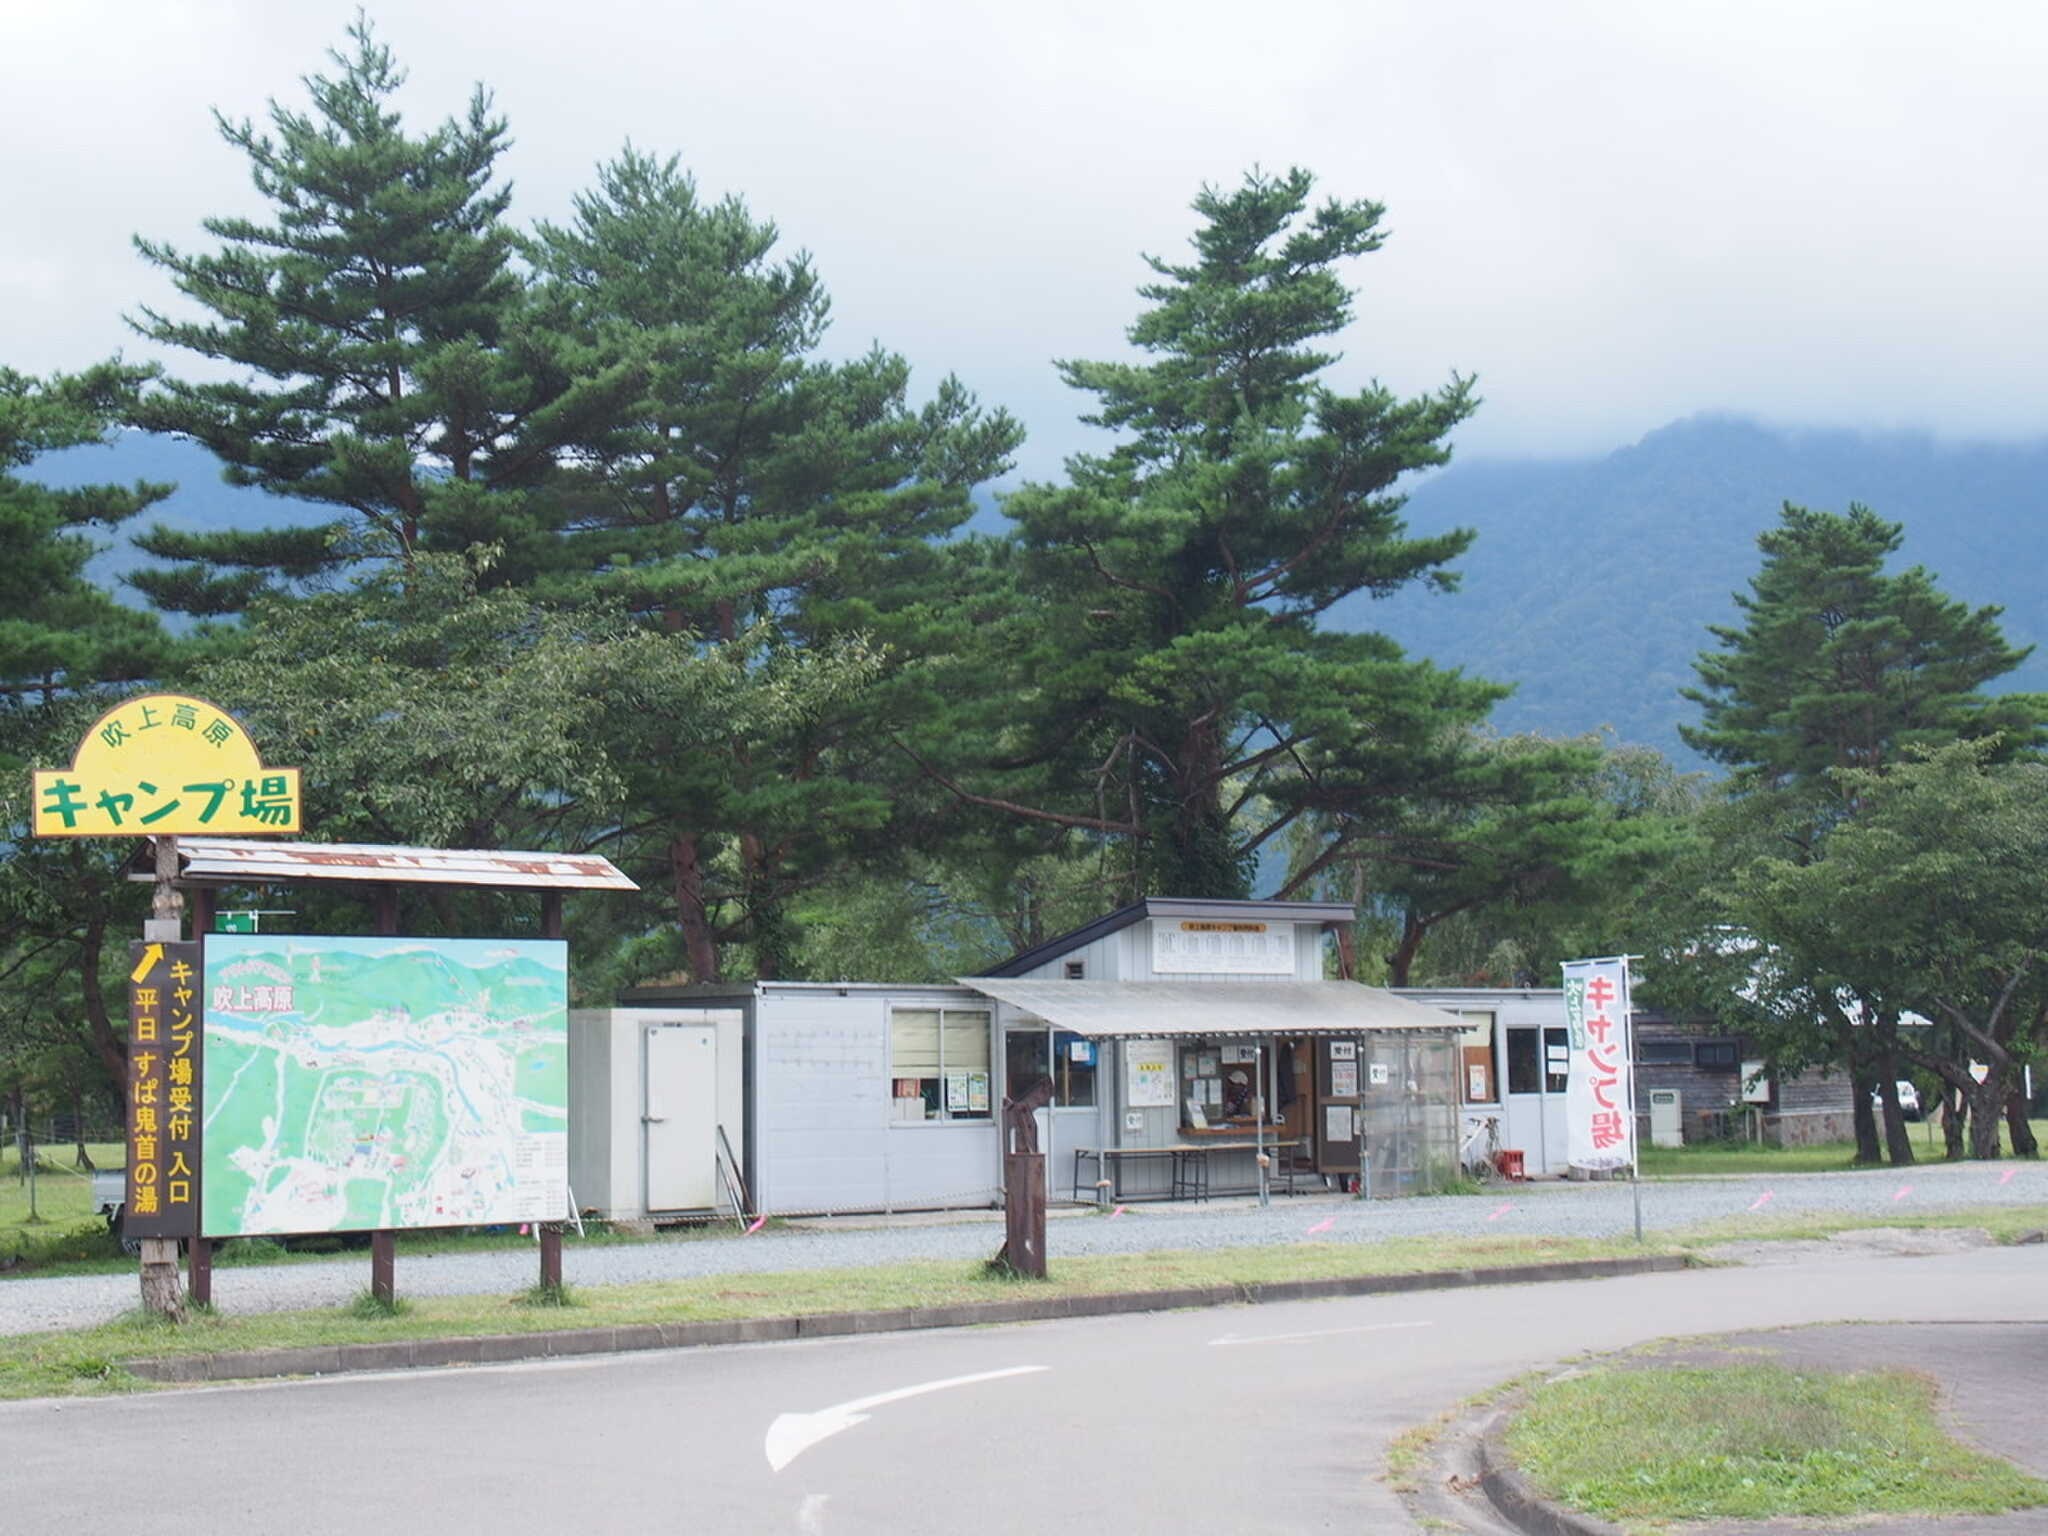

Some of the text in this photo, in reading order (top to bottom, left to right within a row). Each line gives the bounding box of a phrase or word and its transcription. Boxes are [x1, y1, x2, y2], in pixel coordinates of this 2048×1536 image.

[100, 703, 234, 748] 吹上高原
[42, 775, 293, 829] キャンプ場
[213, 985, 294, 1012] 吹上高原
[133, 988, 159, 1214] 平日 すぱ鬼首の湯
[168, 960, 194, 1204] キャンプ場受付 入口
